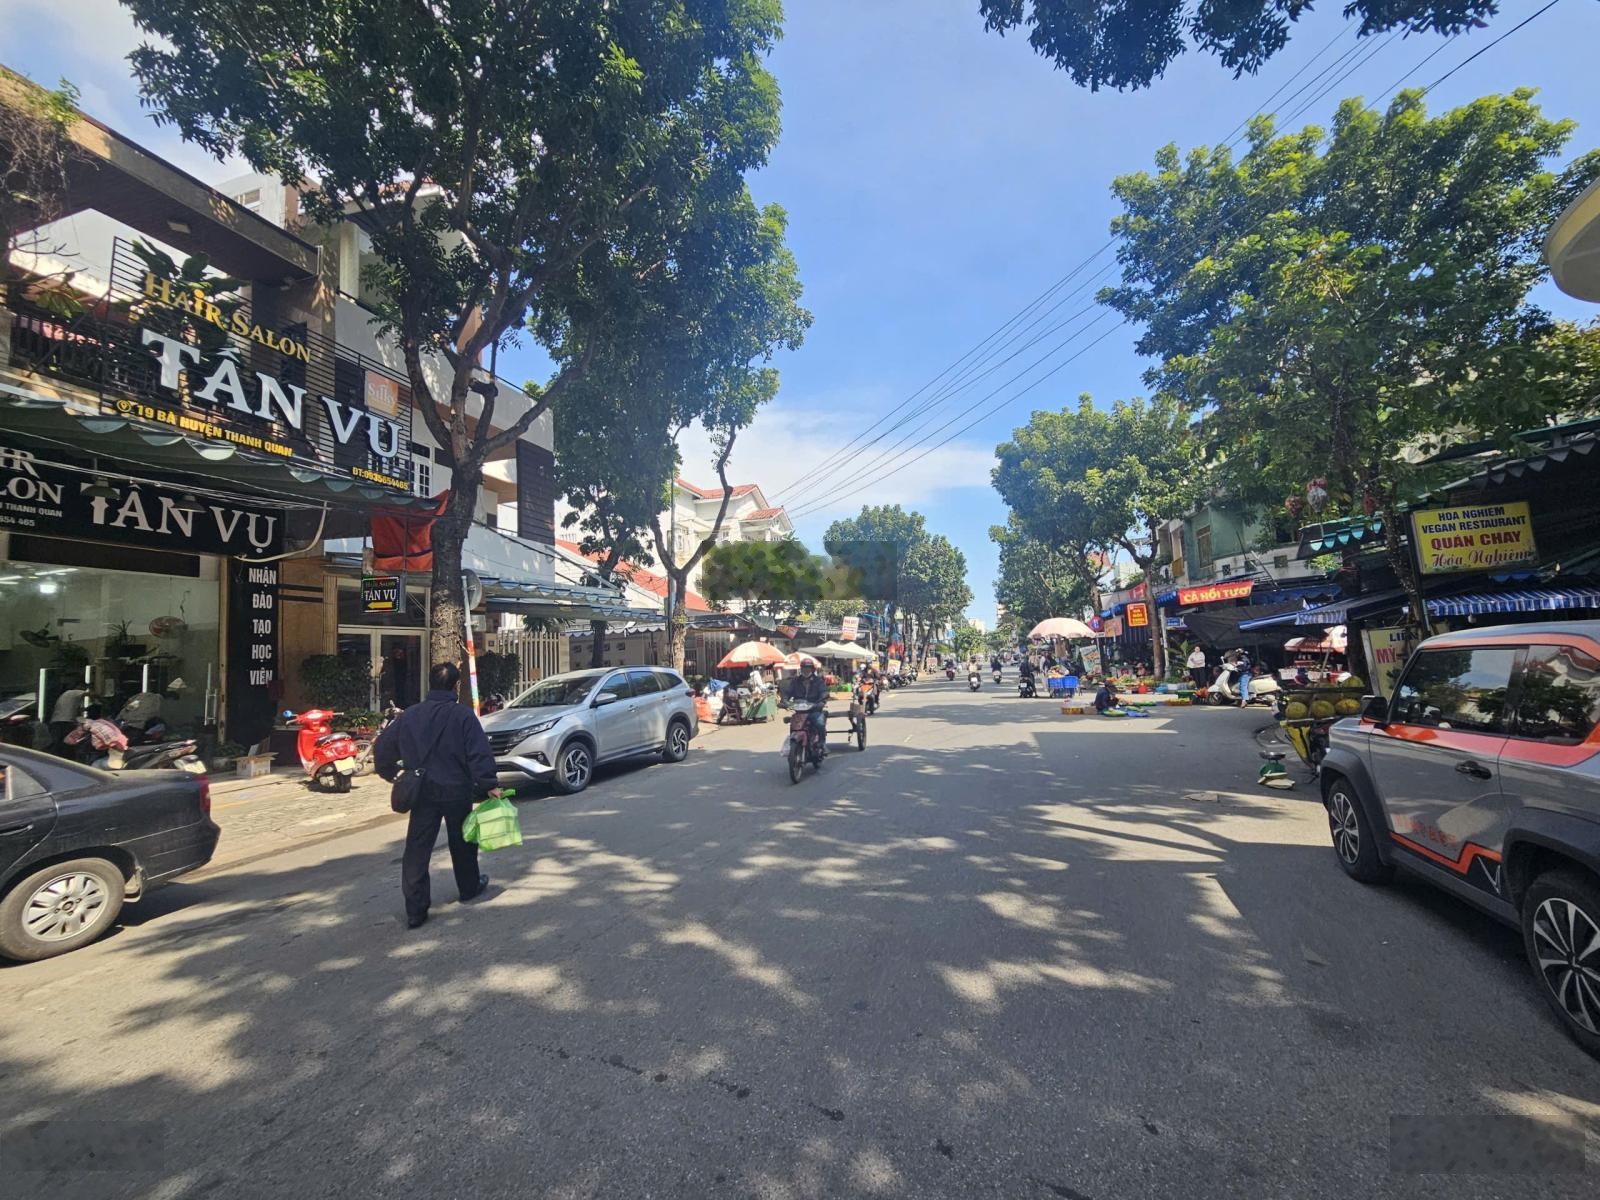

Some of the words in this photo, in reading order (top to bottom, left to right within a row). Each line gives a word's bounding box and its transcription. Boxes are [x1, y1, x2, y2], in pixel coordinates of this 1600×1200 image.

[231, 312, 311, 364] SALON
[137, 404, 153, 419] 19
[156, 410, 176, 425] BÀ
[225, 430, 262, 448] THANH
[264, 441, 293, 458] QUAN
[319, 395, 404, 470] VỤ
[38, 507, 63, 517] QUAN
[1438, 511, 1460, 522] HOA
[1462, 507, 1505, 519] NGHIEM
[210, 506, 277, 553] VỤ
[1422, 522, 1456, 534] VEGAN
[1459, 515, 1526, 531] RESTAURANT
[1431, 534, 1475, 551] QUÁN
[1479, 530, 1521, 546] CHAY
[249, 567, 277, 588] NHẬN
[252, 591, 273, 610] ĐÀO
[252, 619, 273, 637] TẠO
[251, 644, 273, 662] HỌC
